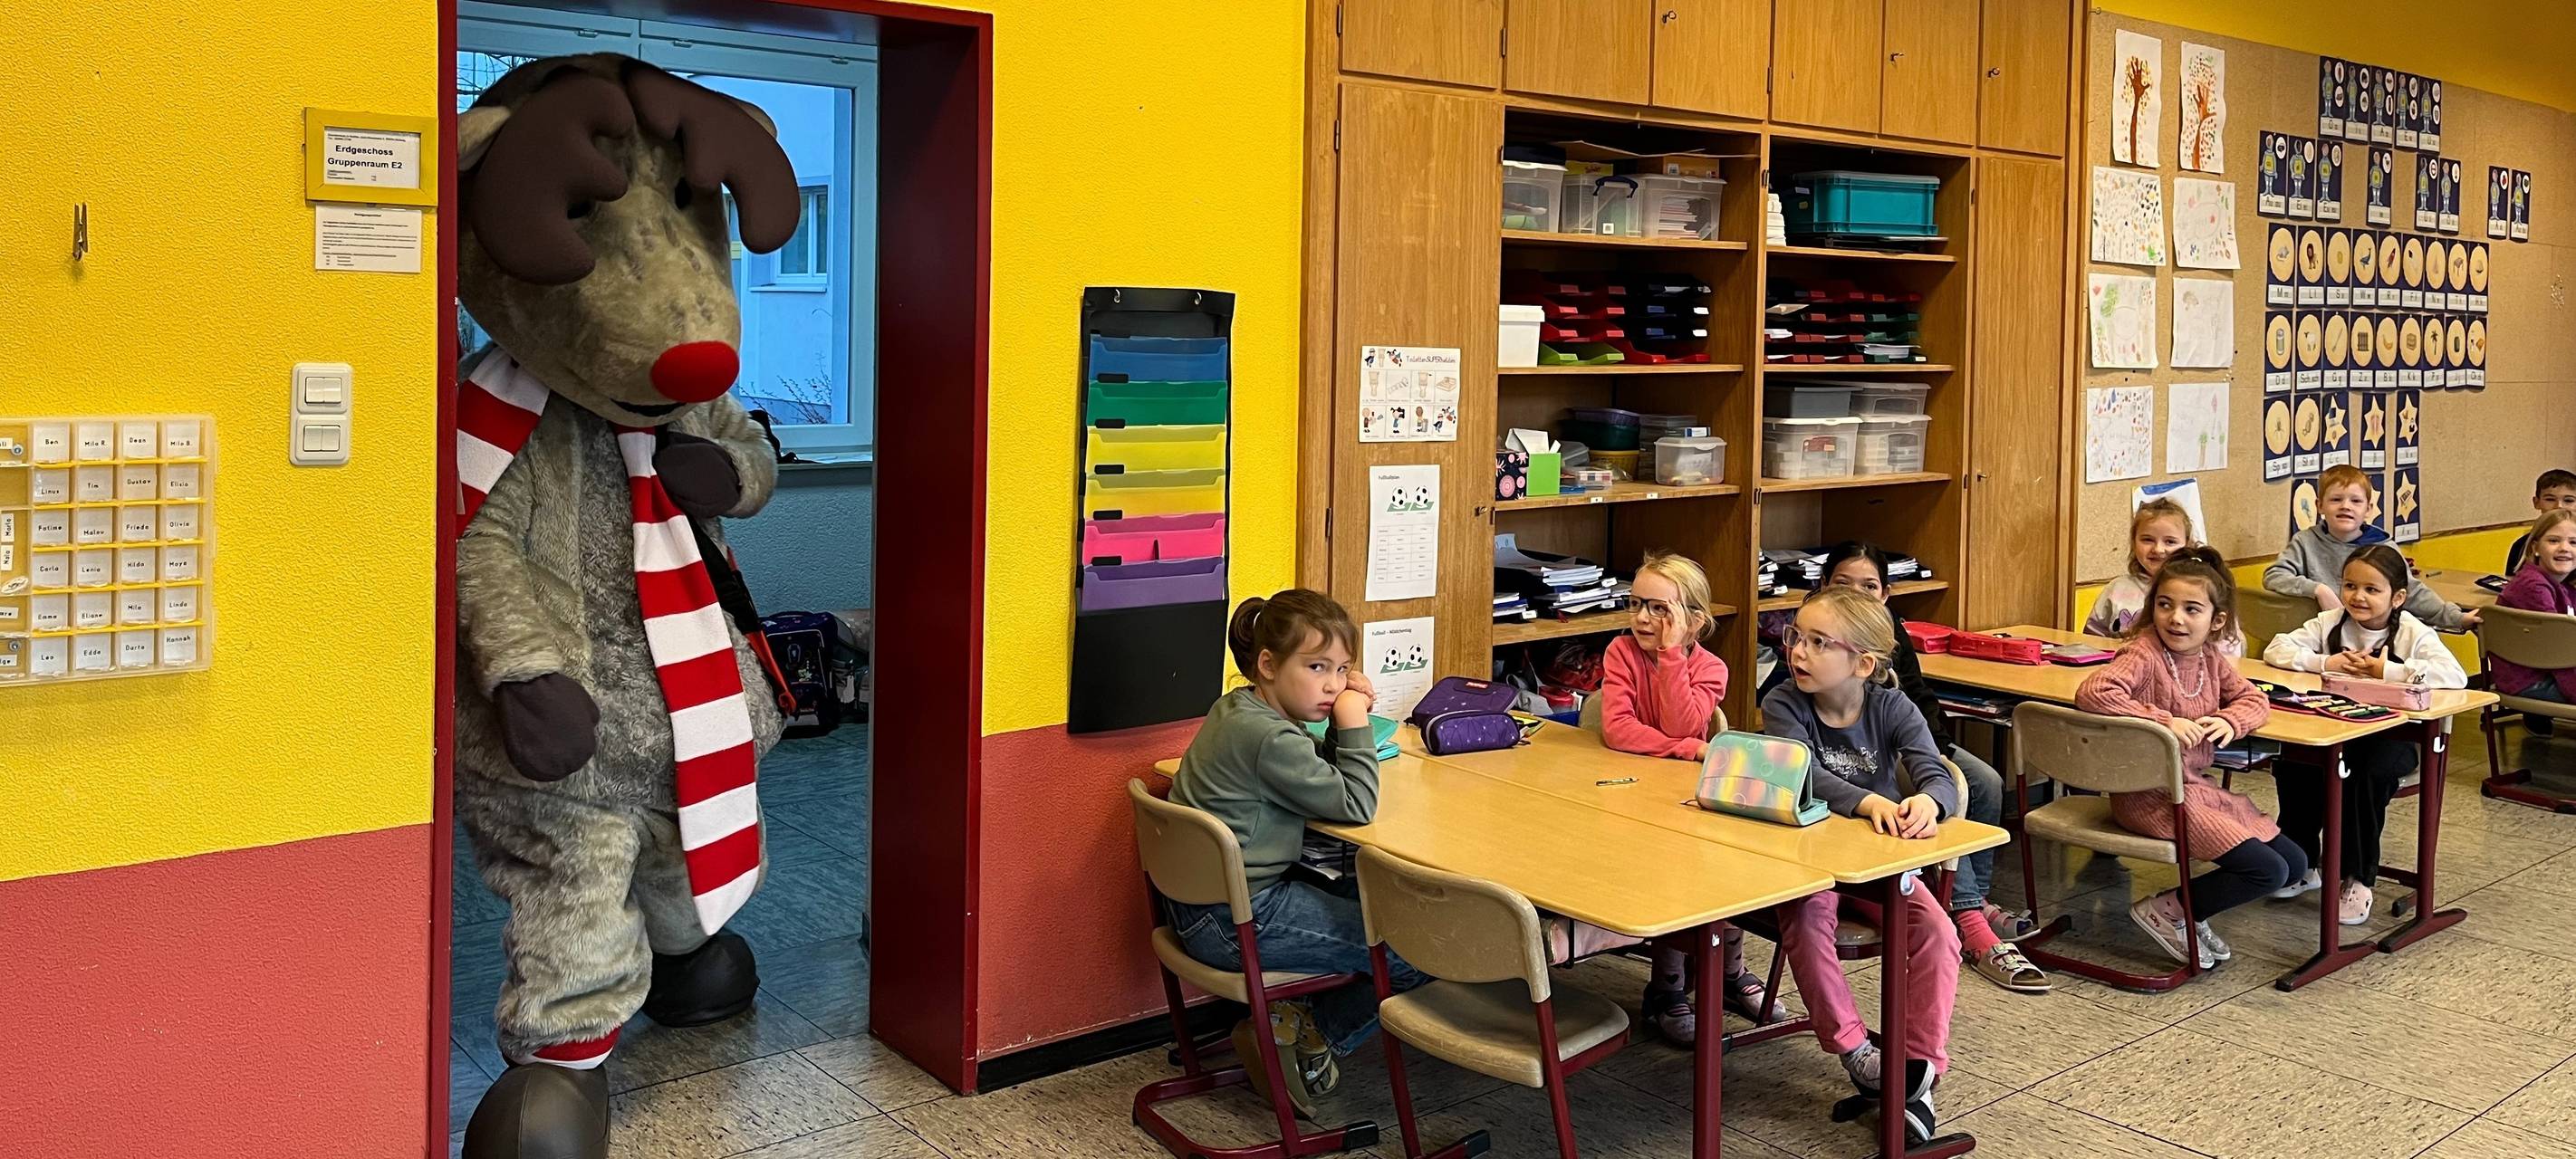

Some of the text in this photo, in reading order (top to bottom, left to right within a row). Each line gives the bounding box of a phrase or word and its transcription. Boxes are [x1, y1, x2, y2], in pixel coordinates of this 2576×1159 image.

[335, 145, 394, 156] Erdgeschoss
[327, 158, 403, 169] Gruppenraum E2
[166, 635, 191, 643] Hannah
